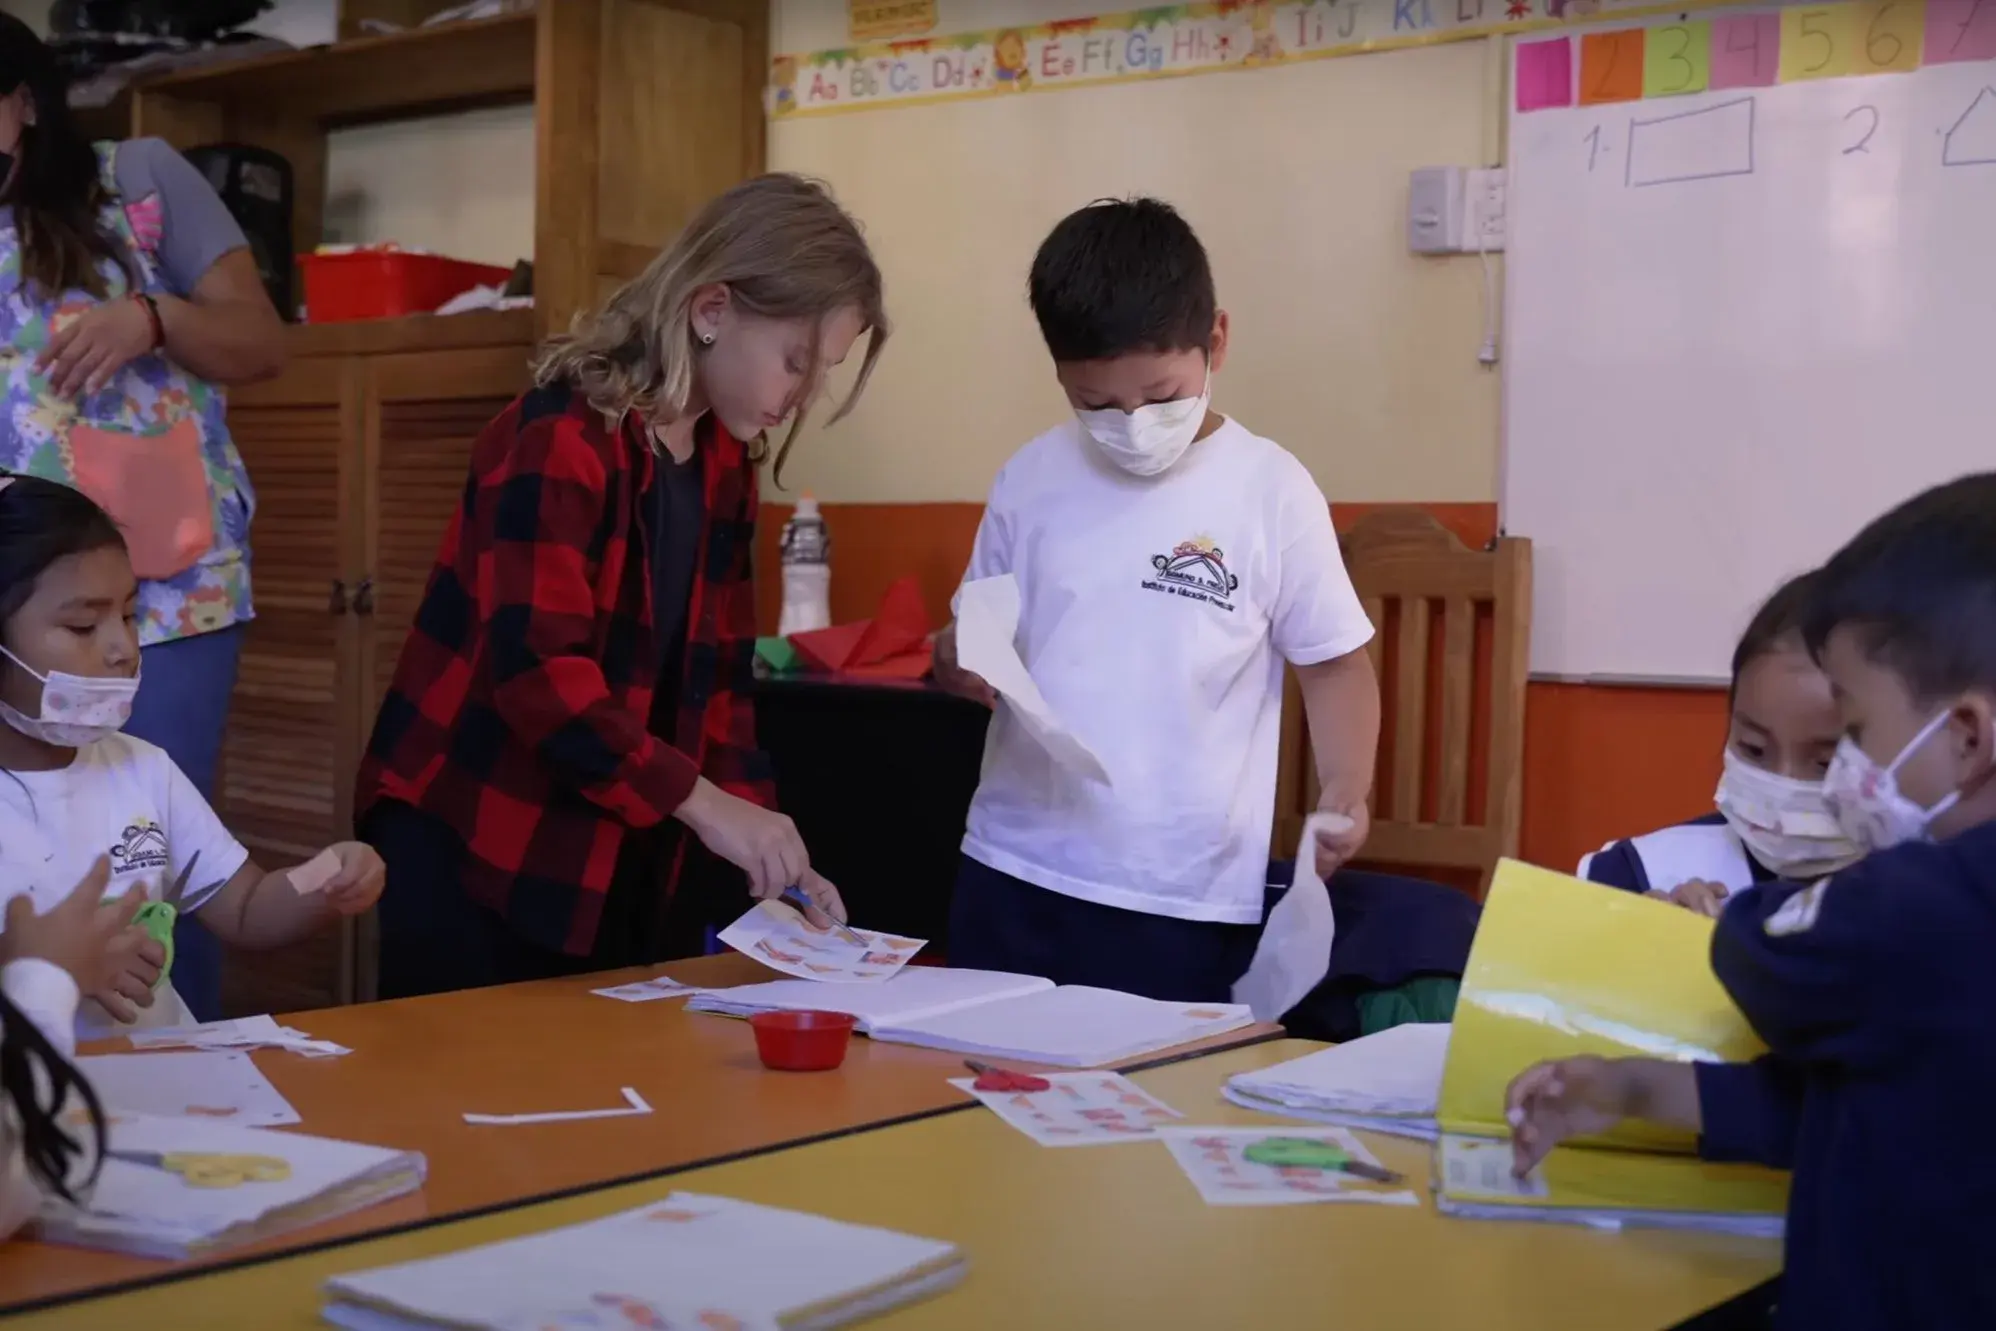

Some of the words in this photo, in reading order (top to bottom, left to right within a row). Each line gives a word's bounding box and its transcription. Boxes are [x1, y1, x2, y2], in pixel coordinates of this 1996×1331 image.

[1040, 42, 1075, 77] Ee
[1592, 32, 1620, 98] 2
[1660, 26, 1693, 92] 3
[1725, 18, 1759, 77] 4
[1801, 12, 1833, 72] 5
[1866, 3, 1903, 66] 6
[1843, 105, 1879, 154] 2
